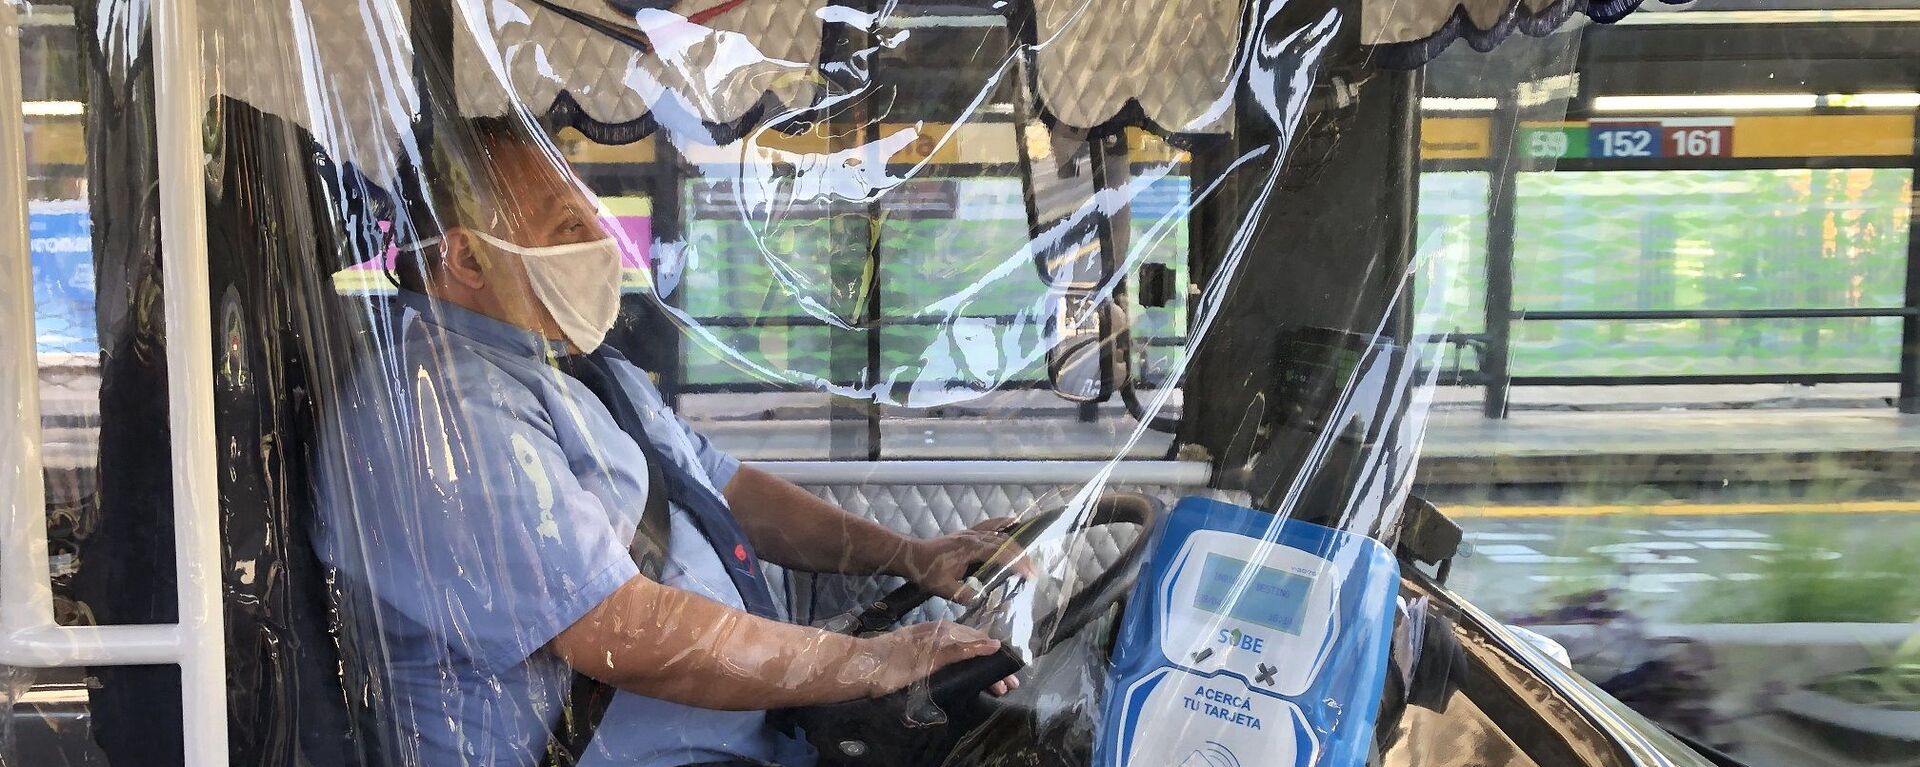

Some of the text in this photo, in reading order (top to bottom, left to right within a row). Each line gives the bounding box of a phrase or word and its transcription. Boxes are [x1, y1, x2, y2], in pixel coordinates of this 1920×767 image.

[1599, 130, 1651, 157] 152
[1672, 130, 1720, 156] 161
[1218, 628, 1264, 653] SUBE
[1184, 697, 1261, 730] TU TARJETA
